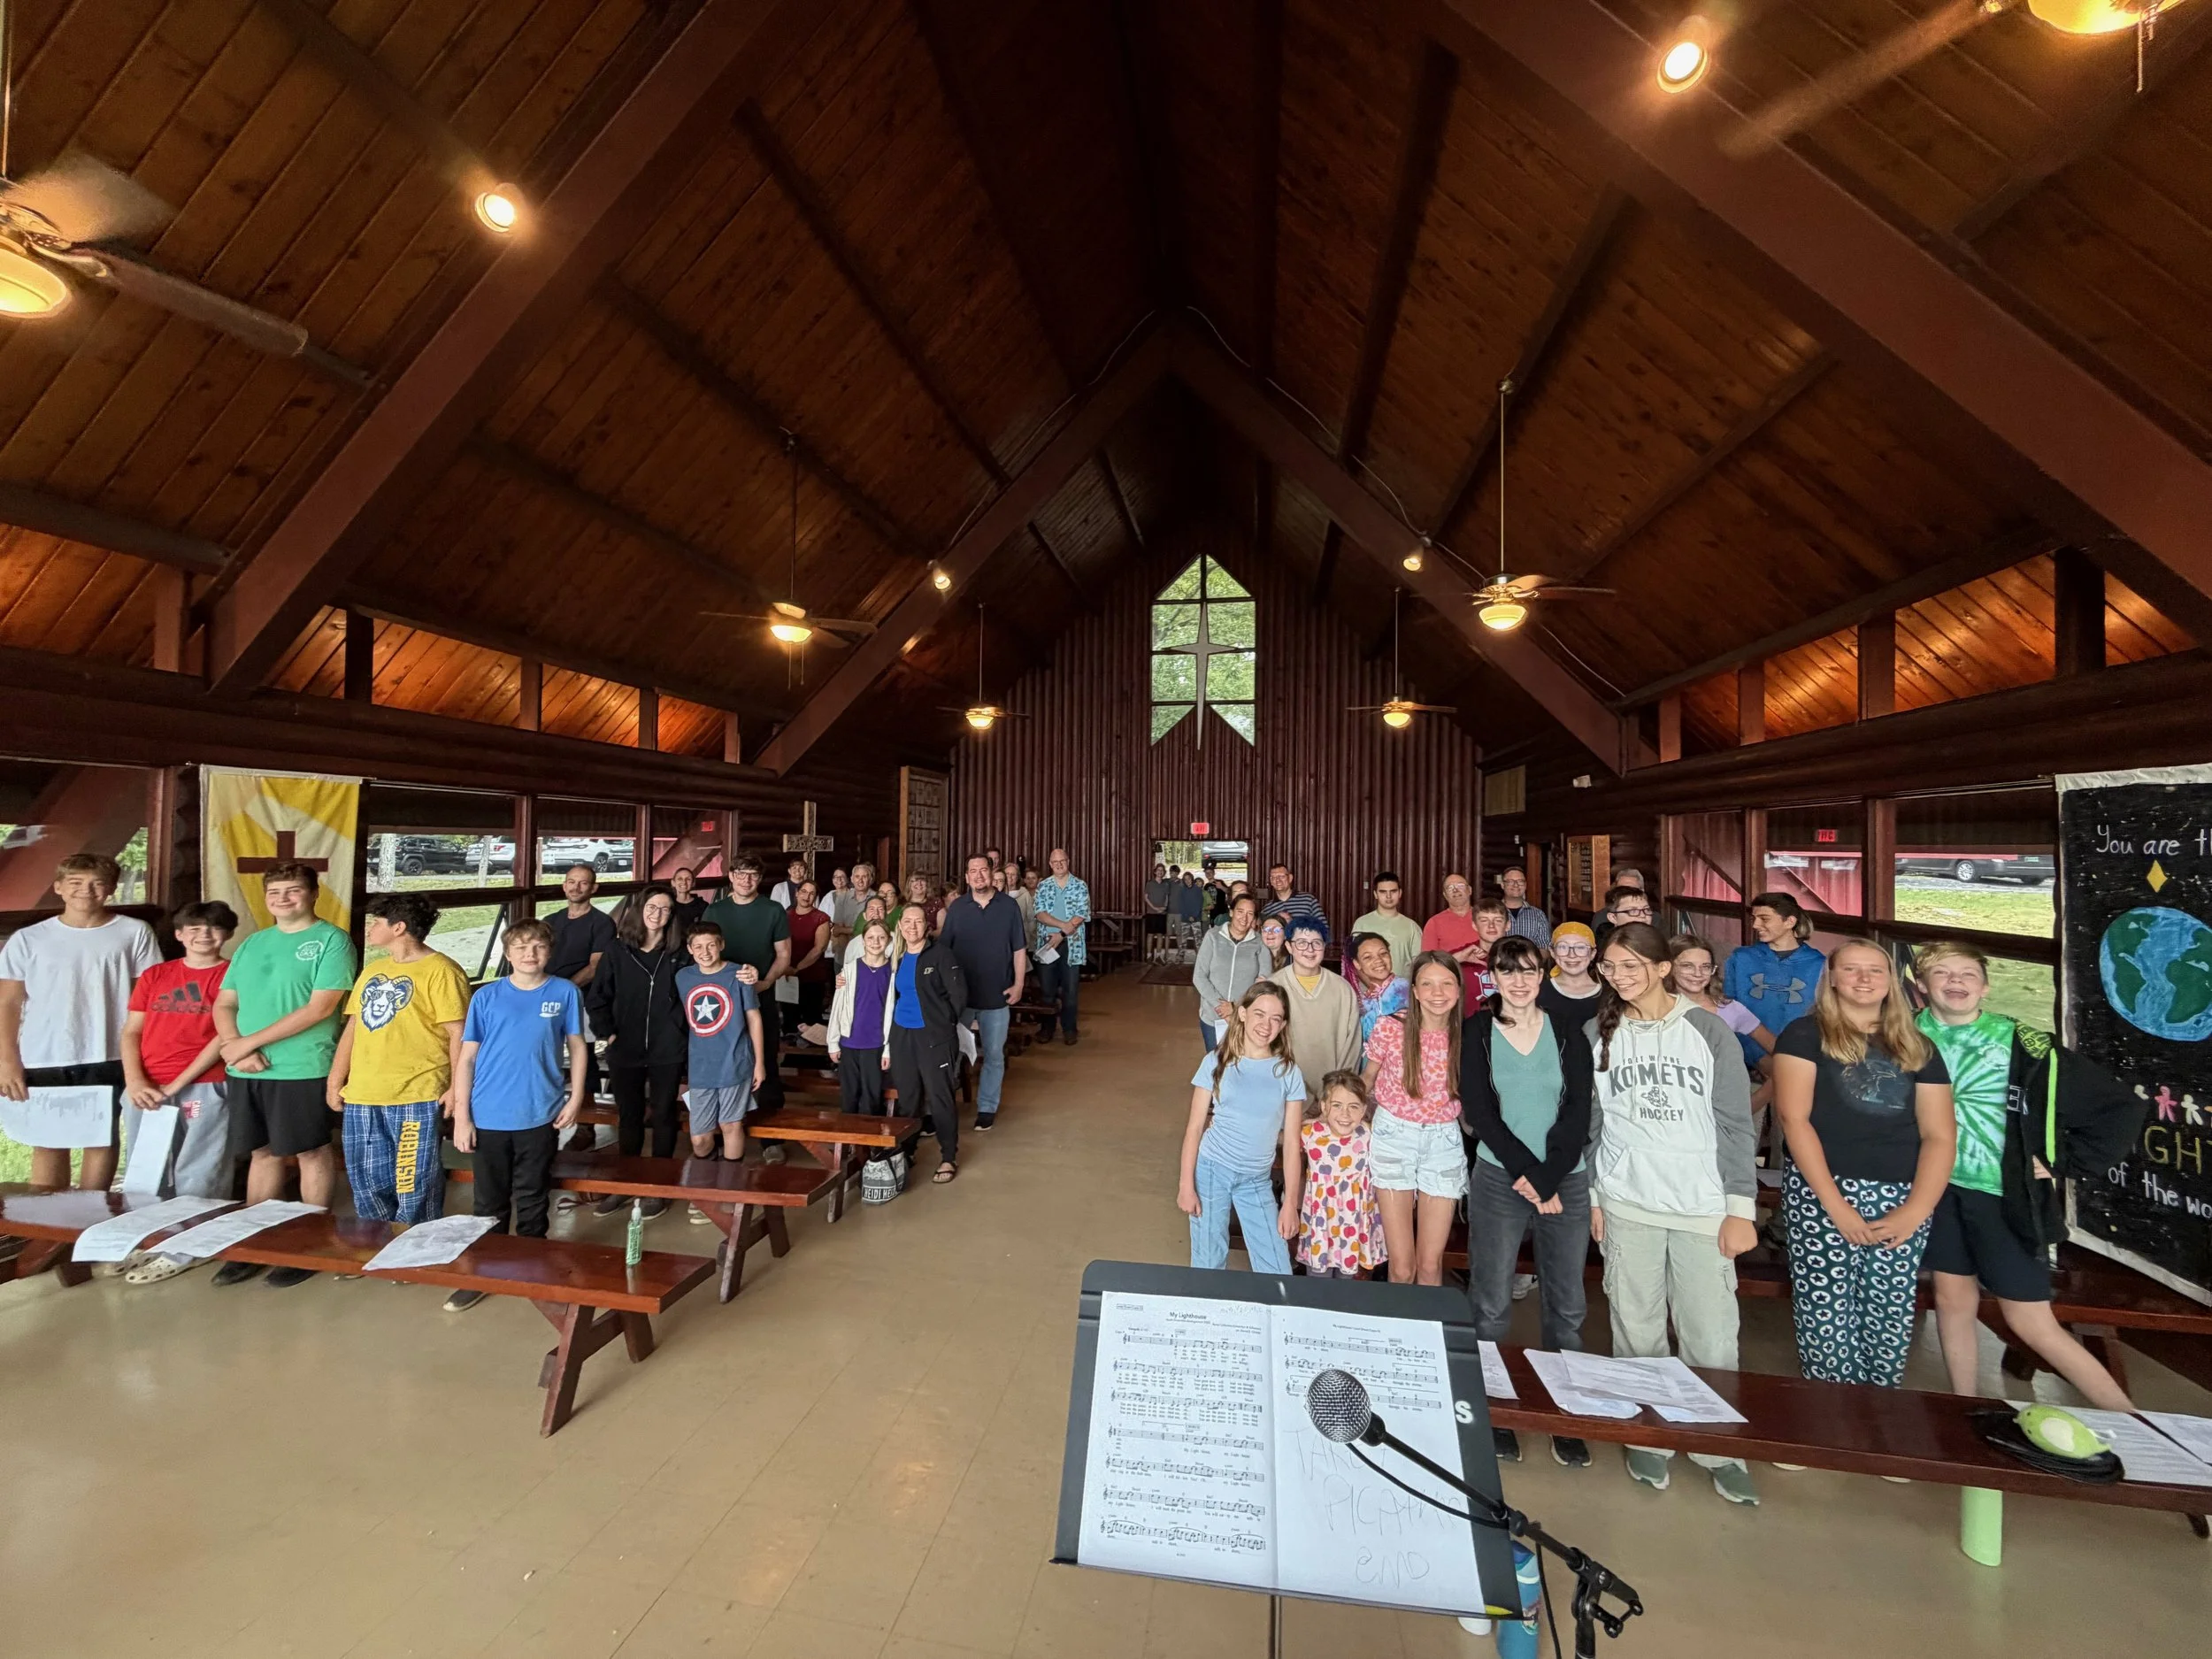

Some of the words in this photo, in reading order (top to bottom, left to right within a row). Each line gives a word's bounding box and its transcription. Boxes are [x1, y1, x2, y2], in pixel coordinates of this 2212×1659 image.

[2096, 823, 2134, 855] You
[2143, 838, 2180, 856] are
[541, 1001, 561, 1013] GCP
[1648, 1054, 1682, 1065] WYNE
[1609, 1063, 1705, 1098] KOMETS
[1640, 1107, 1684, 1122] HOCKEY
[396, 1120, 421, 1194] ROBINSON
[2108, 1162, 2130, 1187] of
[2141, 1171, 2179, 1207] the
